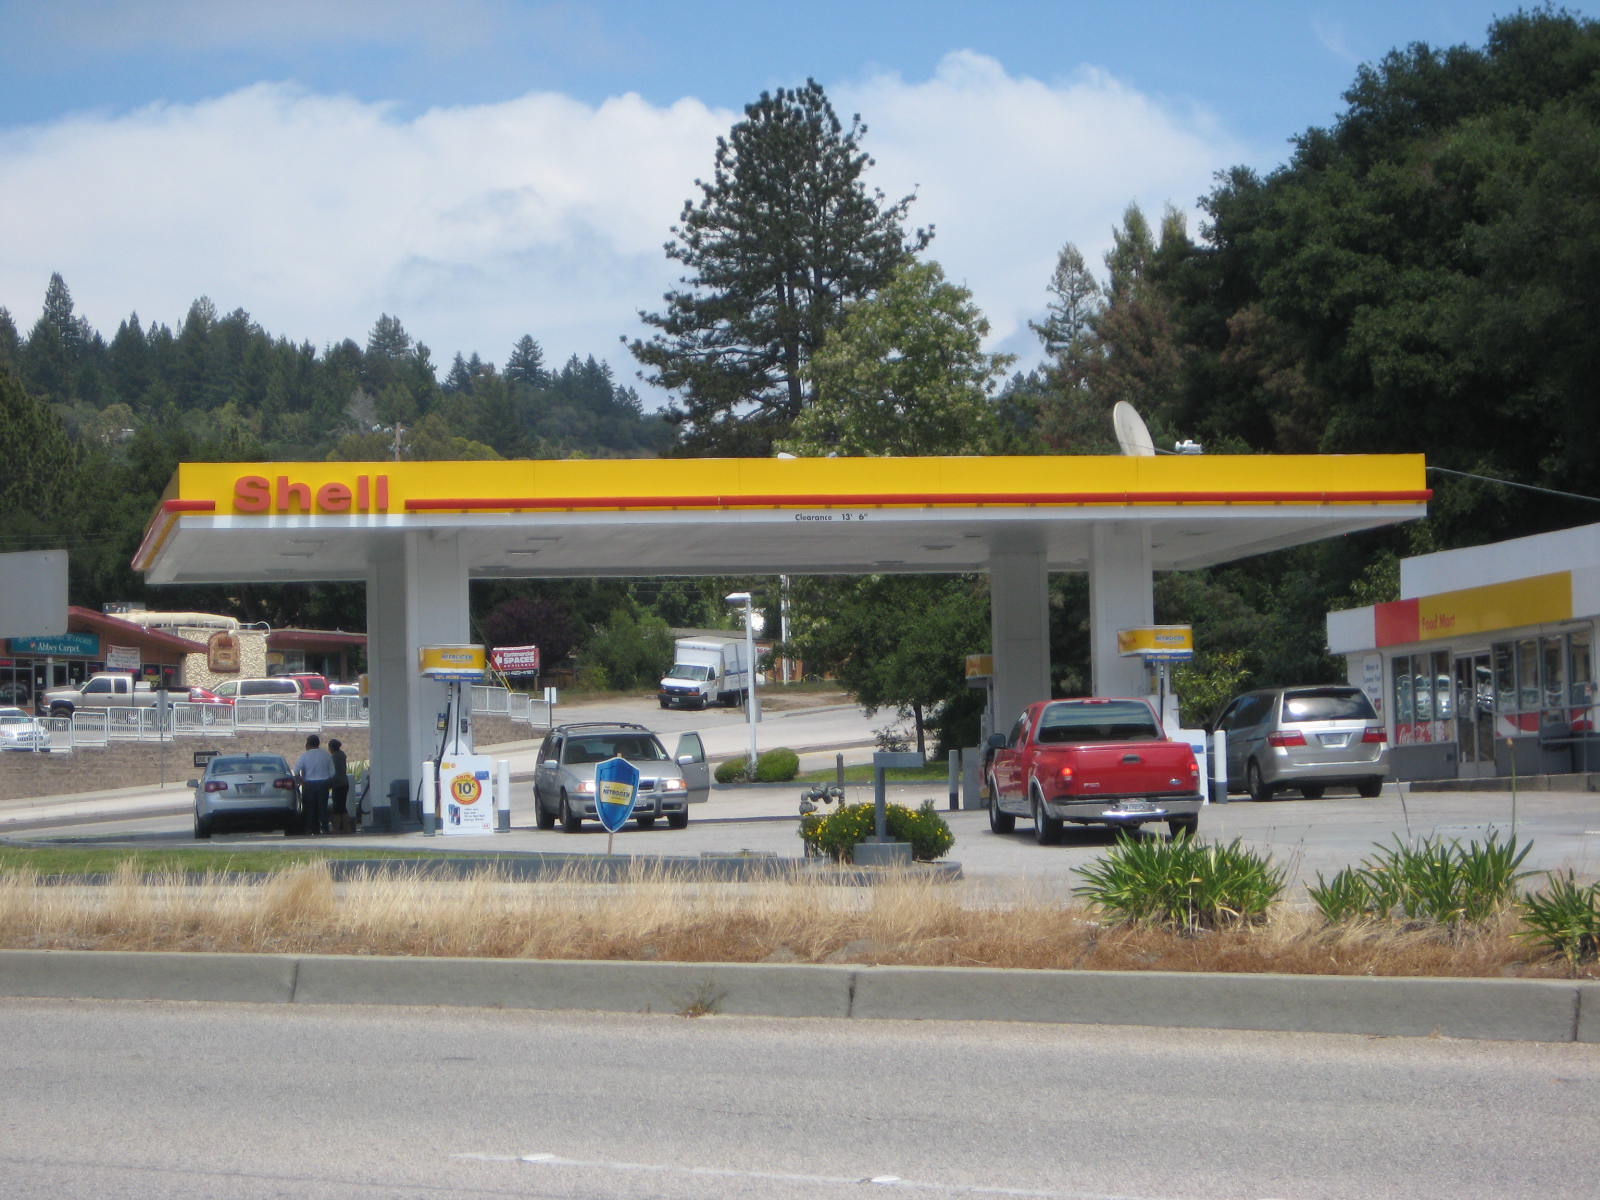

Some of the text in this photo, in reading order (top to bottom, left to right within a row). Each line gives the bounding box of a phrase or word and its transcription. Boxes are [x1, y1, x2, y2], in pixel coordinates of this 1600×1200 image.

[234, 475, 388, 512] Shell
[795, 513, 868, 521] Clearance 13' 6"
[1422, 612, 1456, 631] Food Mart
[37, 642, 80, 653] Abbey Carpet
[503, 656, 535, 664] SPACES
[603, 788, 630, 798] NITROGEN
